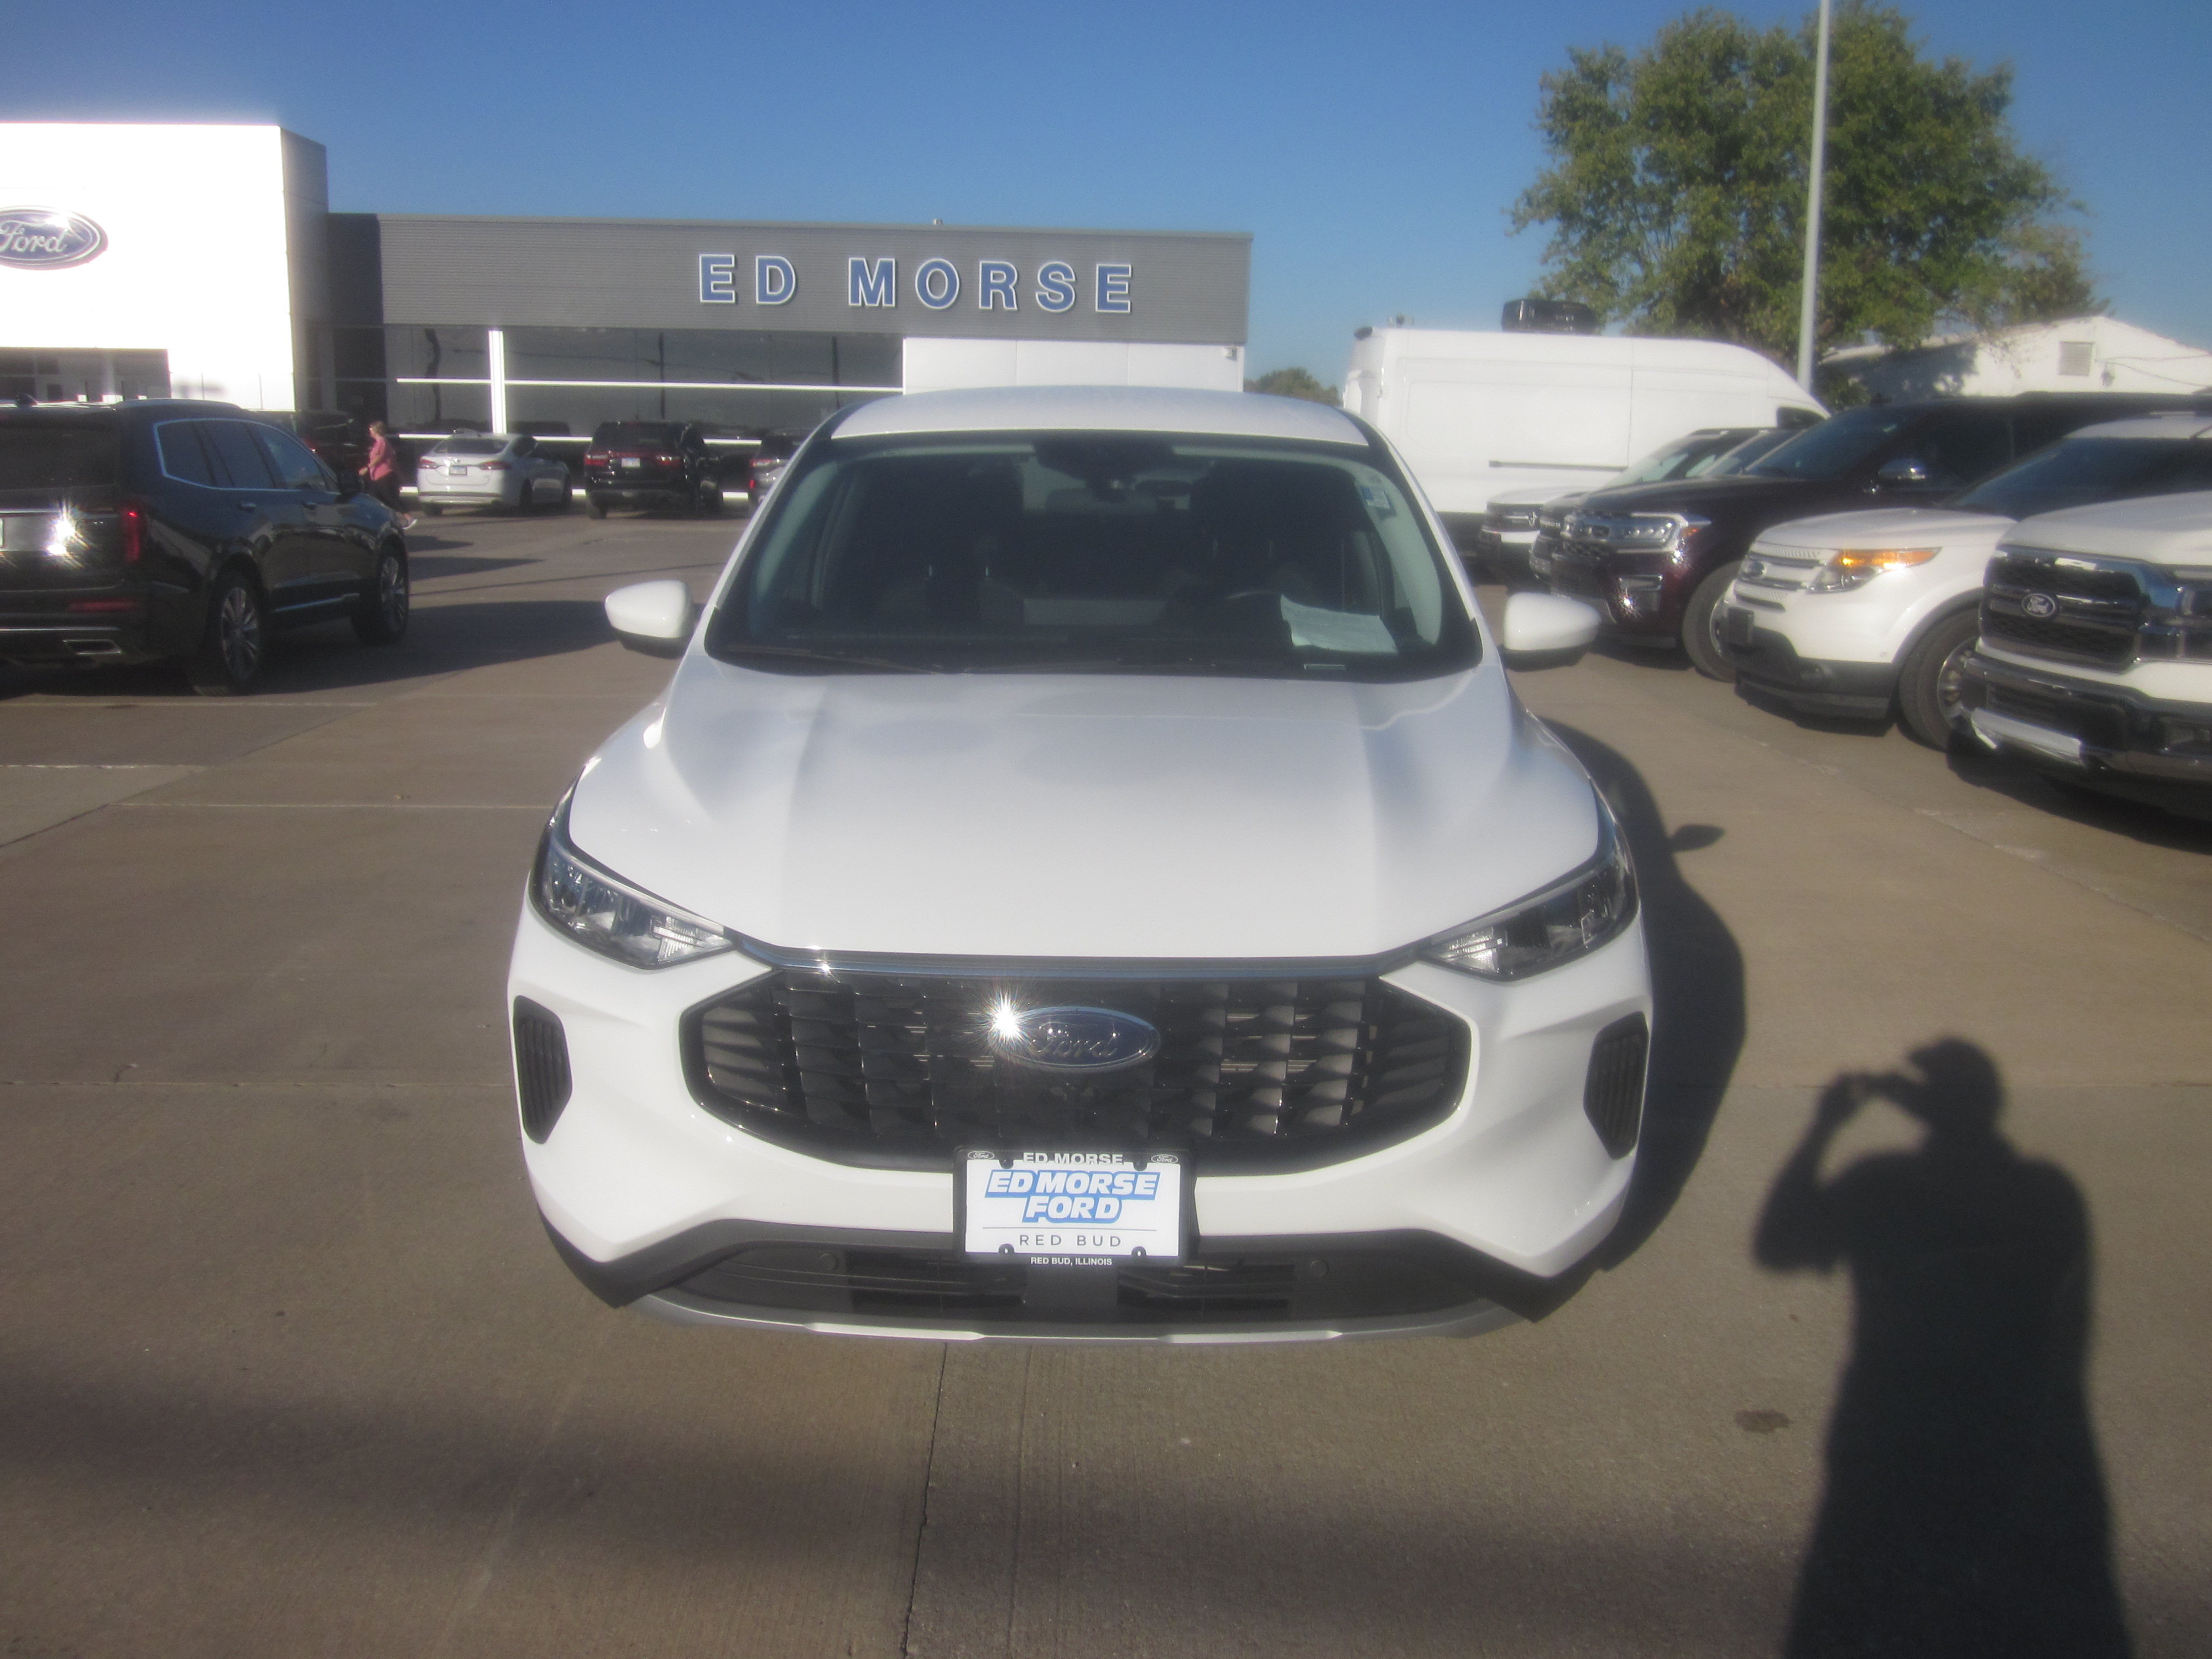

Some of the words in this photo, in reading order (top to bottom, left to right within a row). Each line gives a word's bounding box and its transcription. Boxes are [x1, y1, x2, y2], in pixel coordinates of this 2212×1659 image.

[0, 220, 68, 252] Ford
[698, 254, 797, 305] ED
[848, 257, 1132, 313] MORSE
[1023, 1152, 1048, 1164] ED
[1054, 1153, 1123, 1165] MORSE
[987, 1170, 1034, 1194] ED
[1035, 1171, 1159, 1196] MORSE
[1024, 1195, 1120, 1220] FORD
[1020, 1234, 1061, 1246] RED
[1077, 1235, 1121, 1247] BUD
[1030, 1256, 1049, 1265] RED
[1051, 1258, 1073, 1266] BUD,
